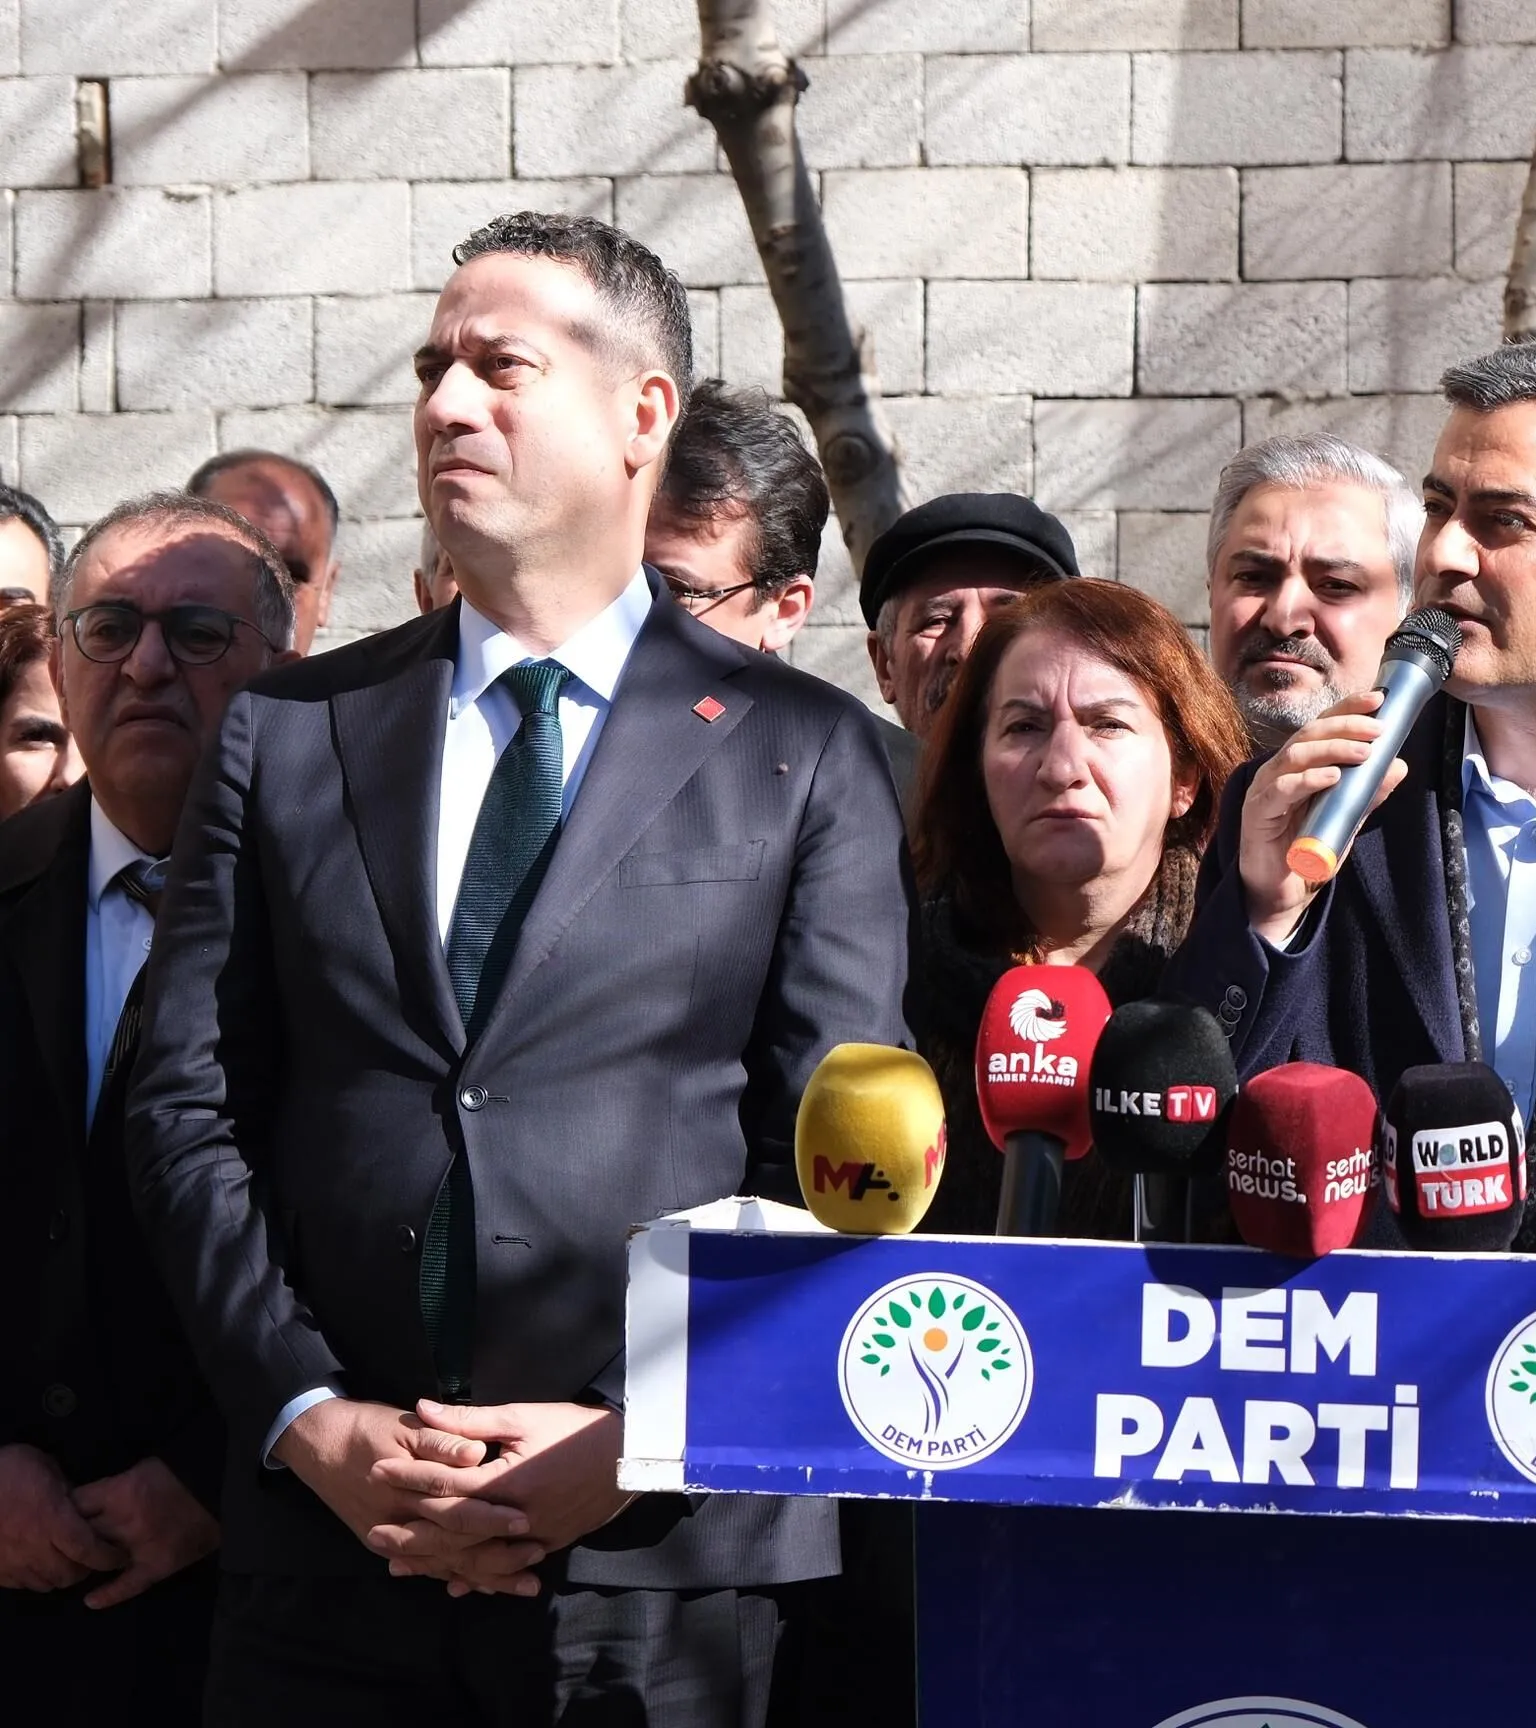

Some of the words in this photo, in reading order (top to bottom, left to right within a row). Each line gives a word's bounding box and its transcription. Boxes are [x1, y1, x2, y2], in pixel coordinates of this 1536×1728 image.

[987, 1043, 1078, 1077] anka
[988, 1073, 1027, 1083] HABER
[1169, 1092, 1213, 1117] TV
[1228, 1149, 1296, 1179] serhat
[1417, 1134, 1504, 1167] WORLD
[1141, 1282, 1378, 1376] DEM
[881, 1424, 923, 1454] DEM
[927, 1424, 987, 1456] PARTİ
[1094, 1384, 1420, 1489] PARTİ
